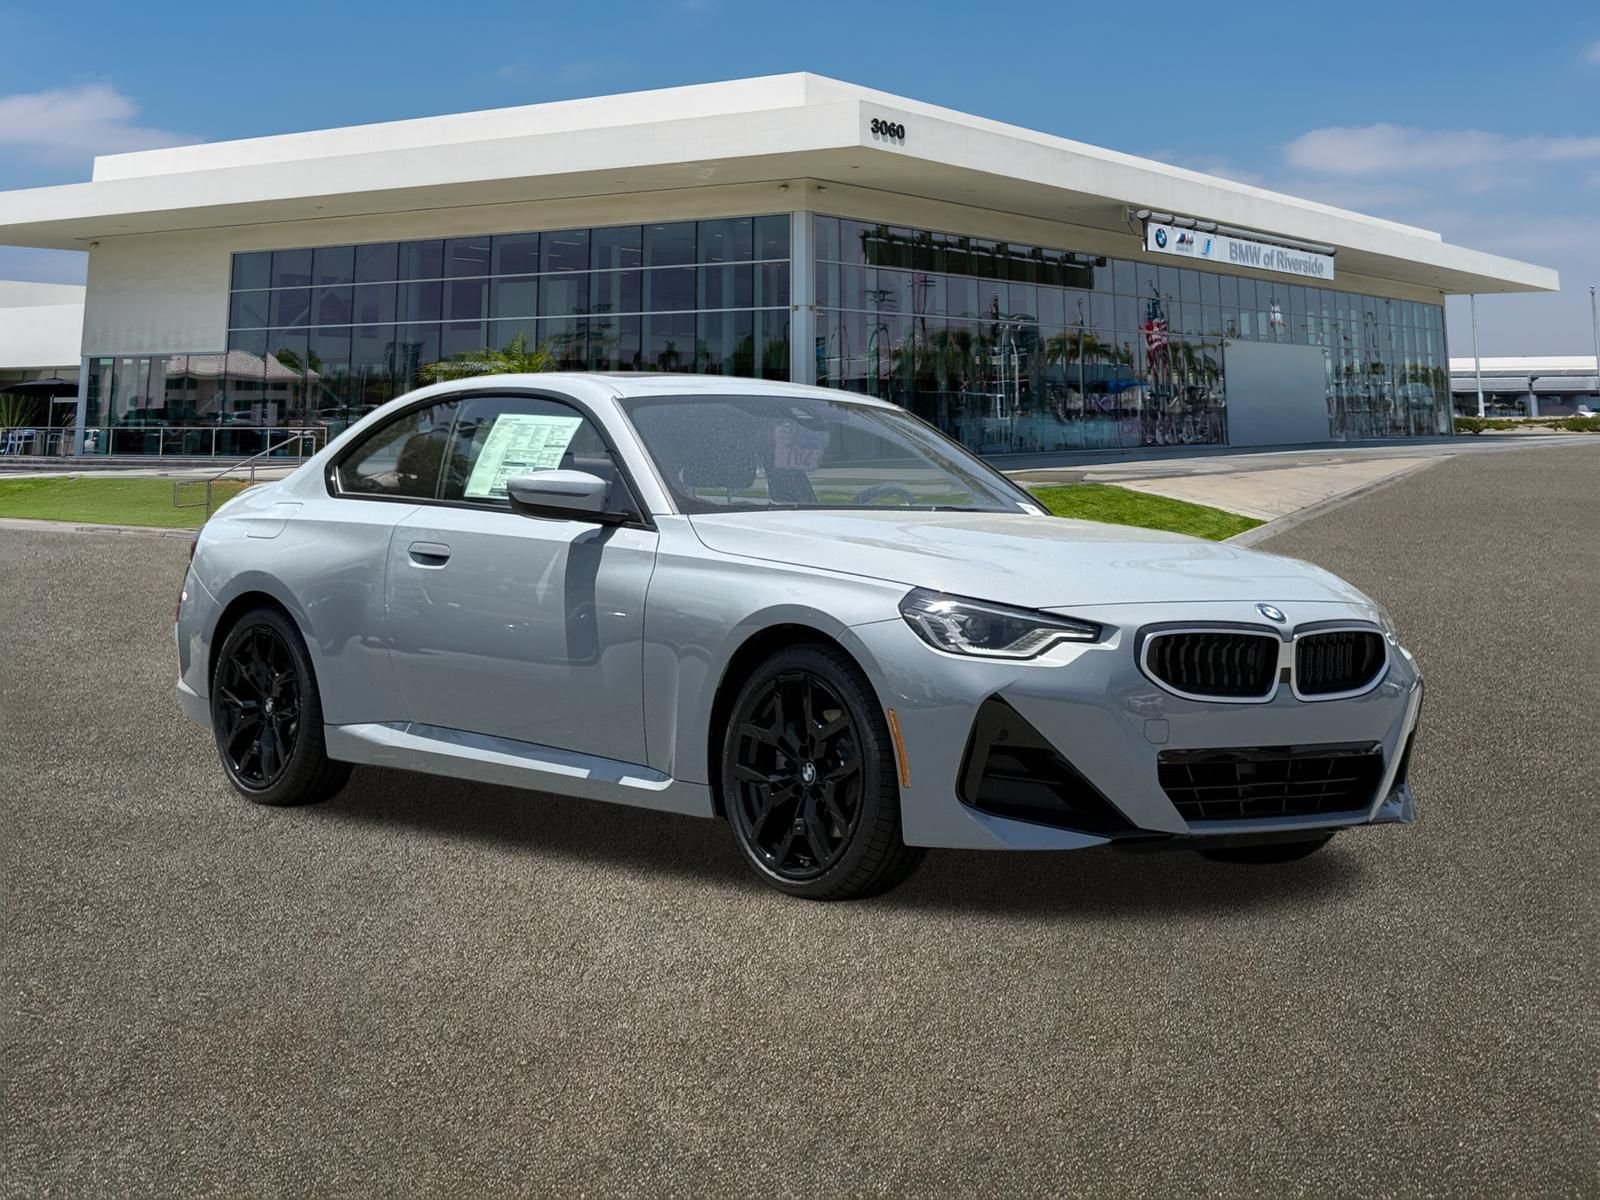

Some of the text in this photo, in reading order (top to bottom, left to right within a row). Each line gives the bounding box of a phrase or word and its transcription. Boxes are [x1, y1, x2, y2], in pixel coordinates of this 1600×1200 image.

[871, 118, 905, 139] 3060
[1229, 242, 1261, 265] BMW
[1263, 251, 1275, 266] of
[1276, 252, 1324, 275] Riverside
